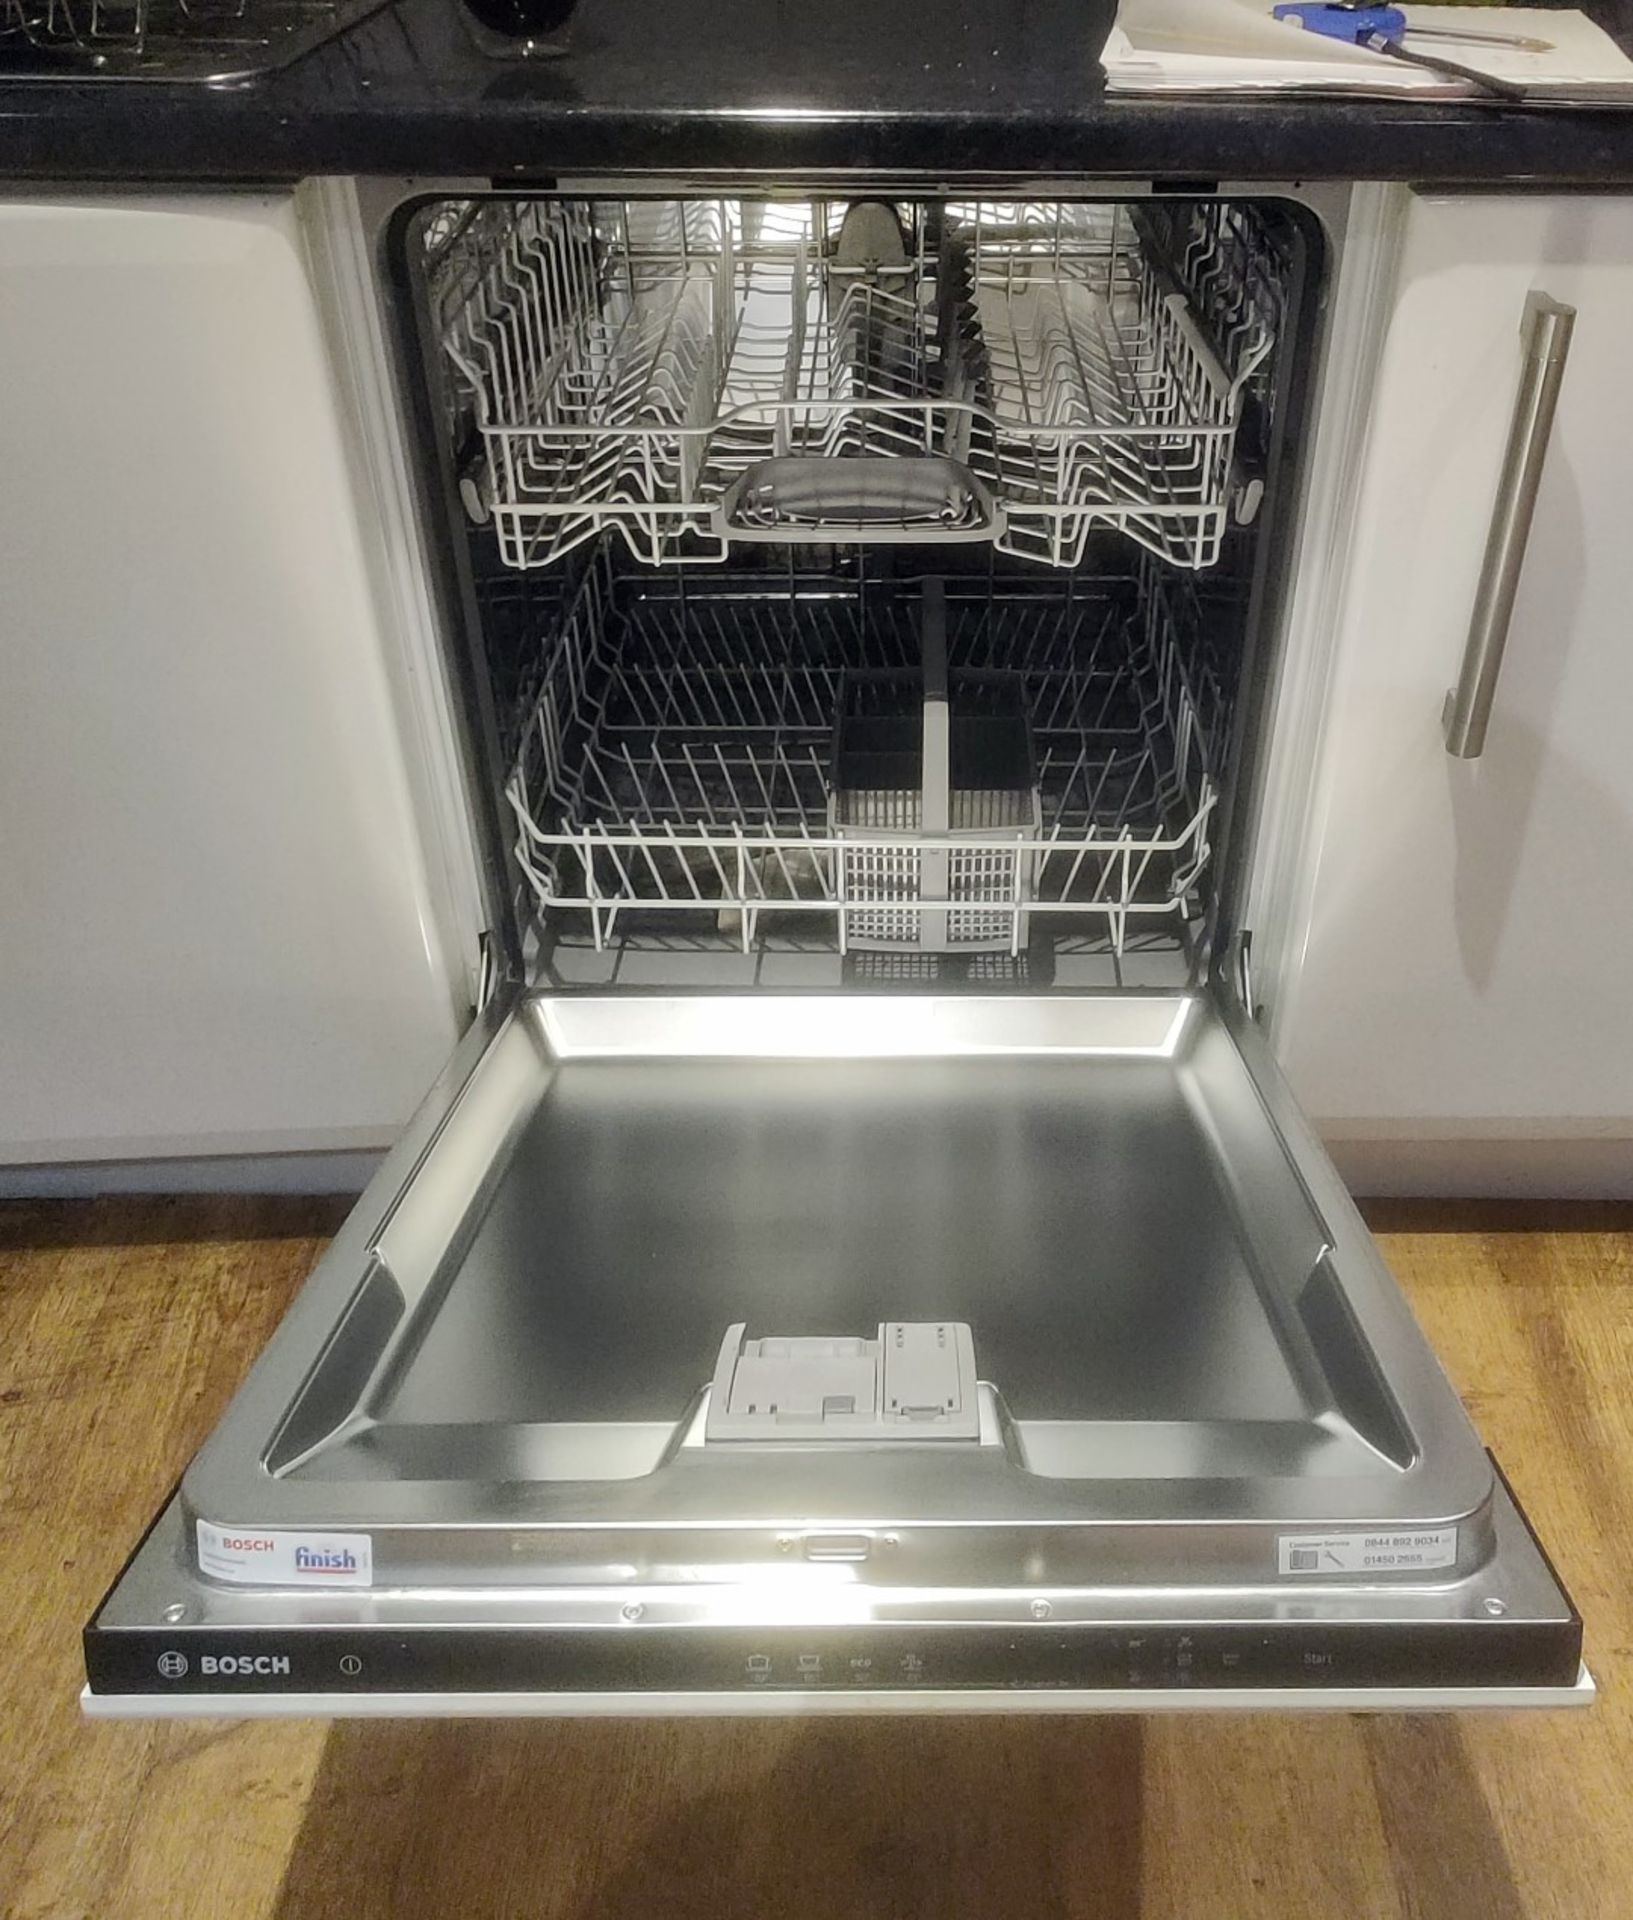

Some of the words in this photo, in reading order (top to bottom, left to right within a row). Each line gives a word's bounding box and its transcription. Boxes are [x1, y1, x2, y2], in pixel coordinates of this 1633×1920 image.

[223, 1538, 274, 1551] BOSCH
[1364, 1537, 1390, 1547] 0844
[1414, 1536, 1440, 1545] 9034
[295, 1546, 356, 1568] finish
[1364, 1554, 1395, 1565] 01450
[1303, 1652, 1332, 1665] Start
[200, 1656, 290, 1675] BOSCH
